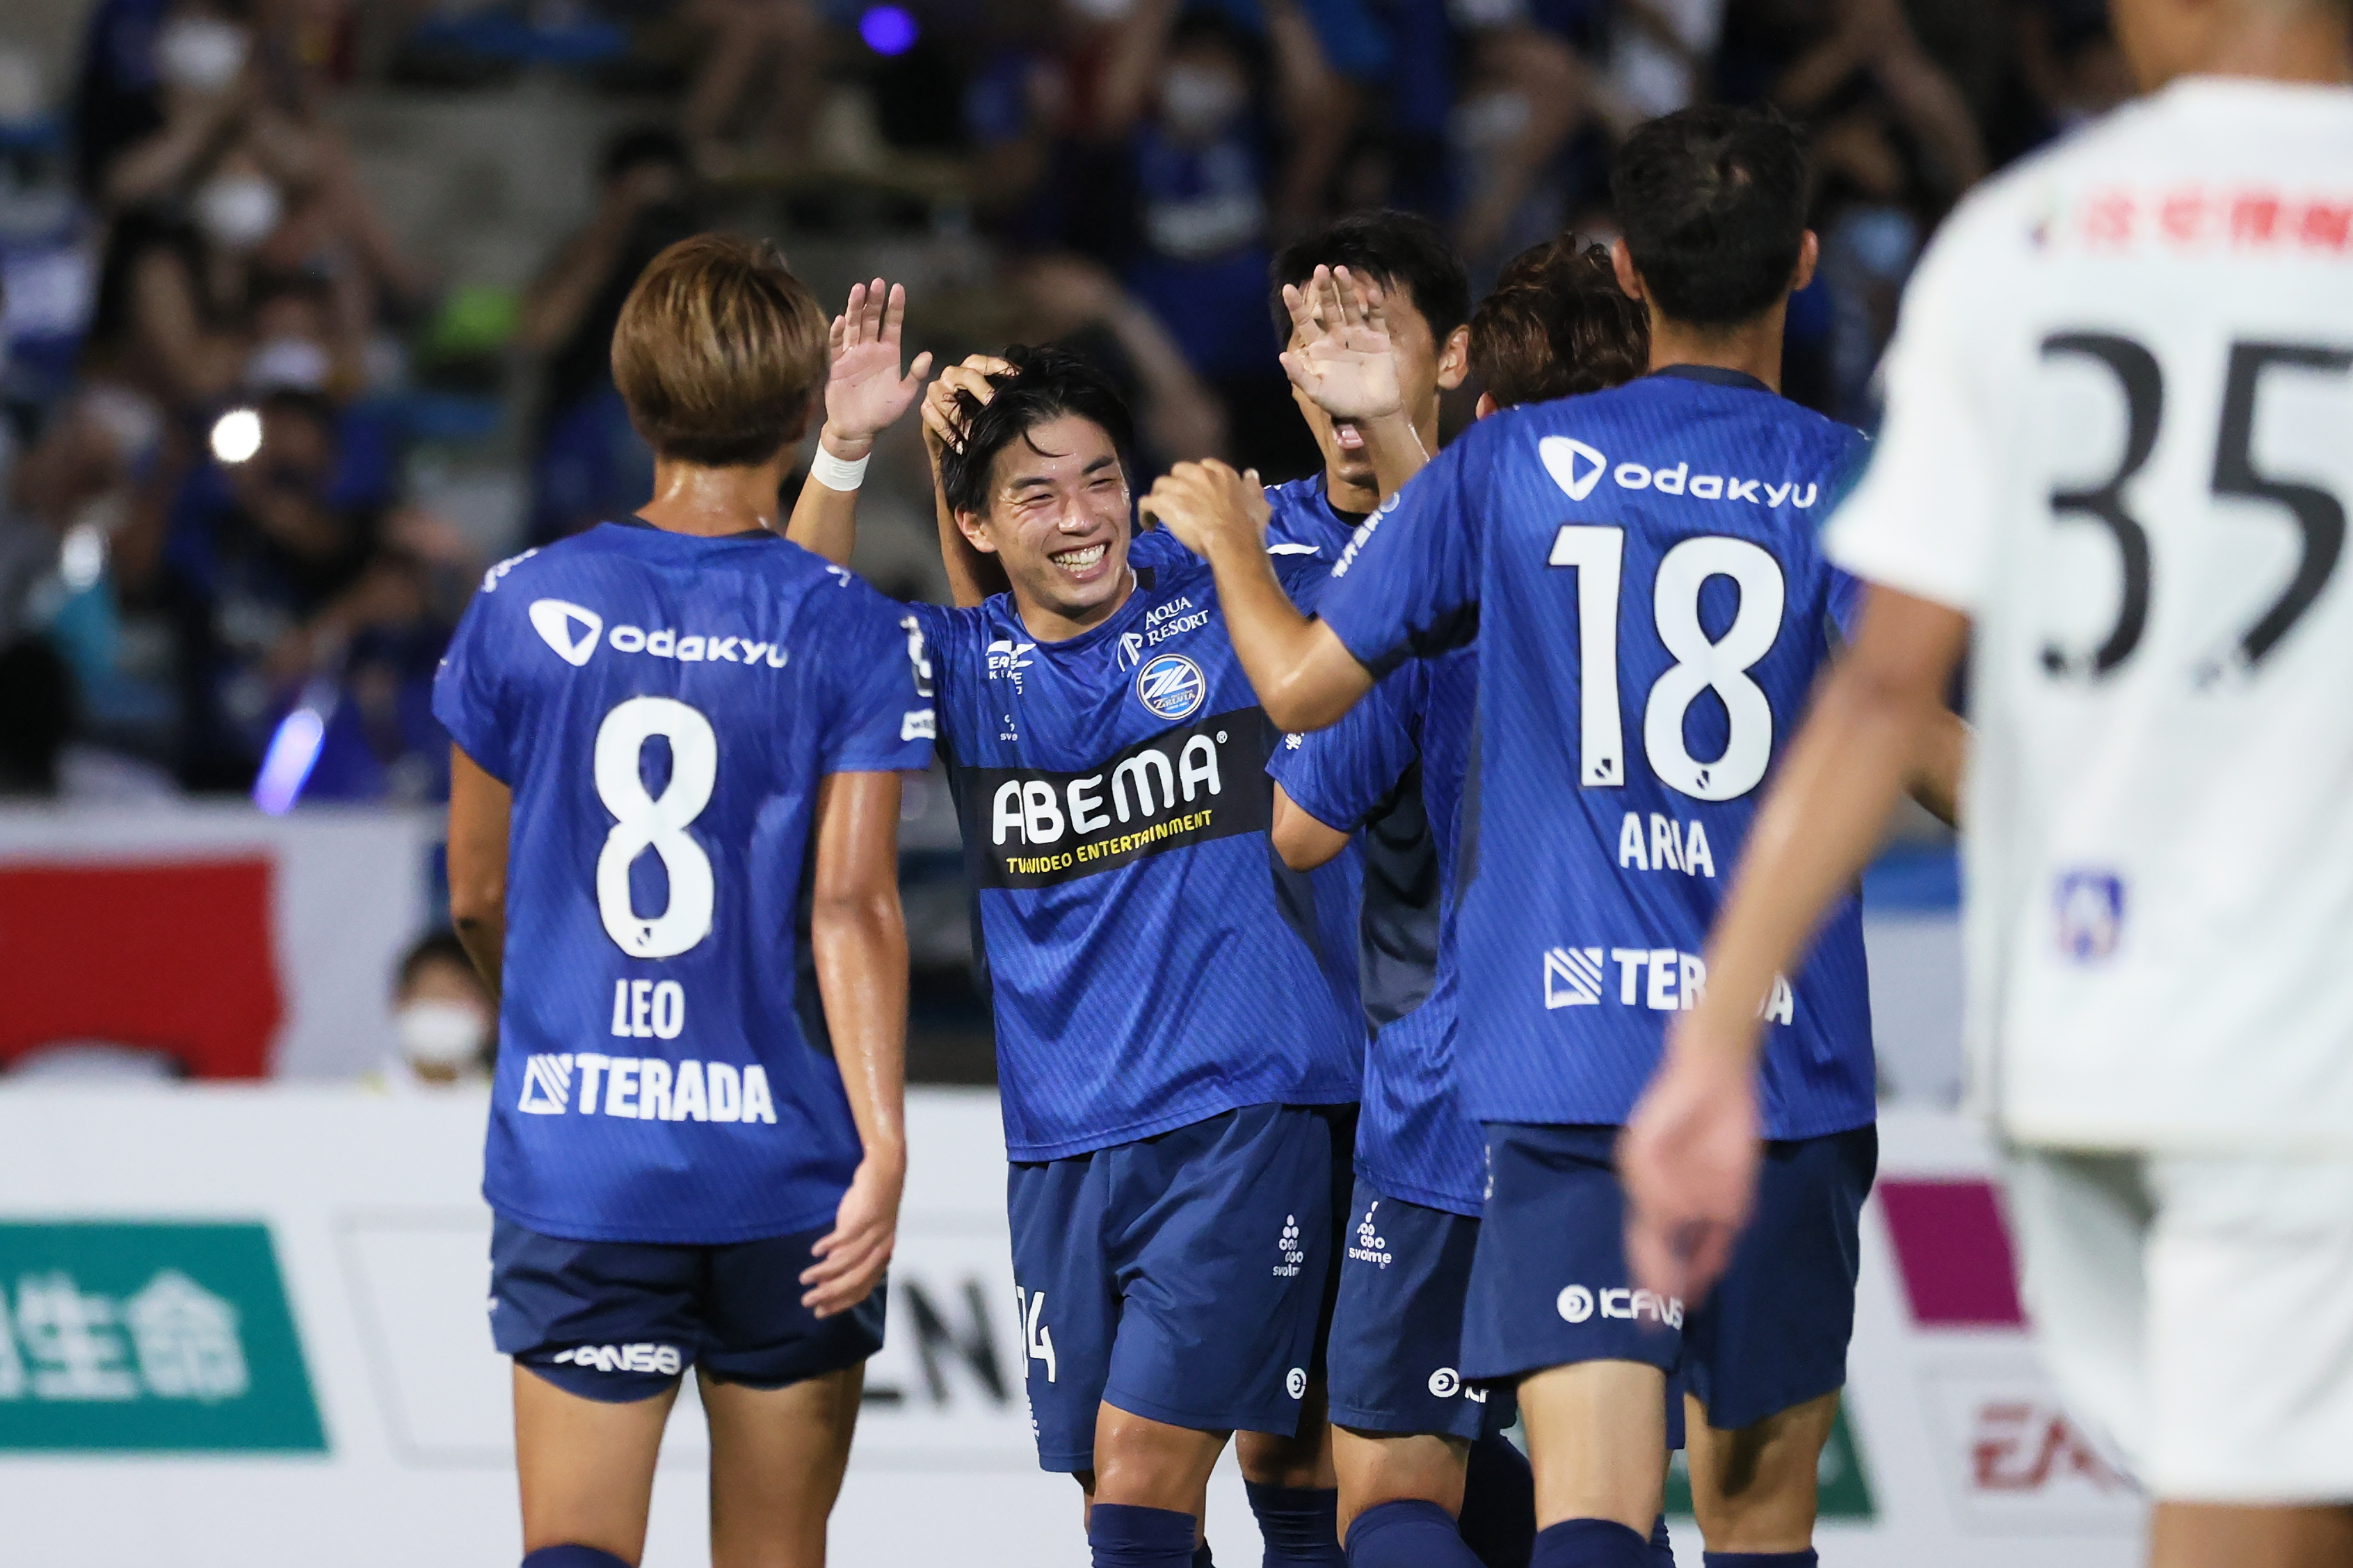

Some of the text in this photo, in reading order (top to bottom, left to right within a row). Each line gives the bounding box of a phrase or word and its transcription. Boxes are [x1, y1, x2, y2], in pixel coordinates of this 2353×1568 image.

[1614, 462, 1817, 509] odakyu
[2035, 330, 2353, 678] 35
[1145, 597, 1193, 631] AQUA
[1146, 610, 1209, 647] RESORT
[609, 624, 789, 668] odakyu
[1549, 525, 1785, 802] 18
[992, 734, 1222, 846] ABEMA
[594, 694, 718, 958] 8
[1077, 809, 1213, 863] ENTERTAINMENT
[1619, 812, 1716, 878] ARIA
[611, 979, 685, 1040] LEO
[575, 1052, 778, 1124] TERADA
[1349, 1247, 1392, 1263] svolme
